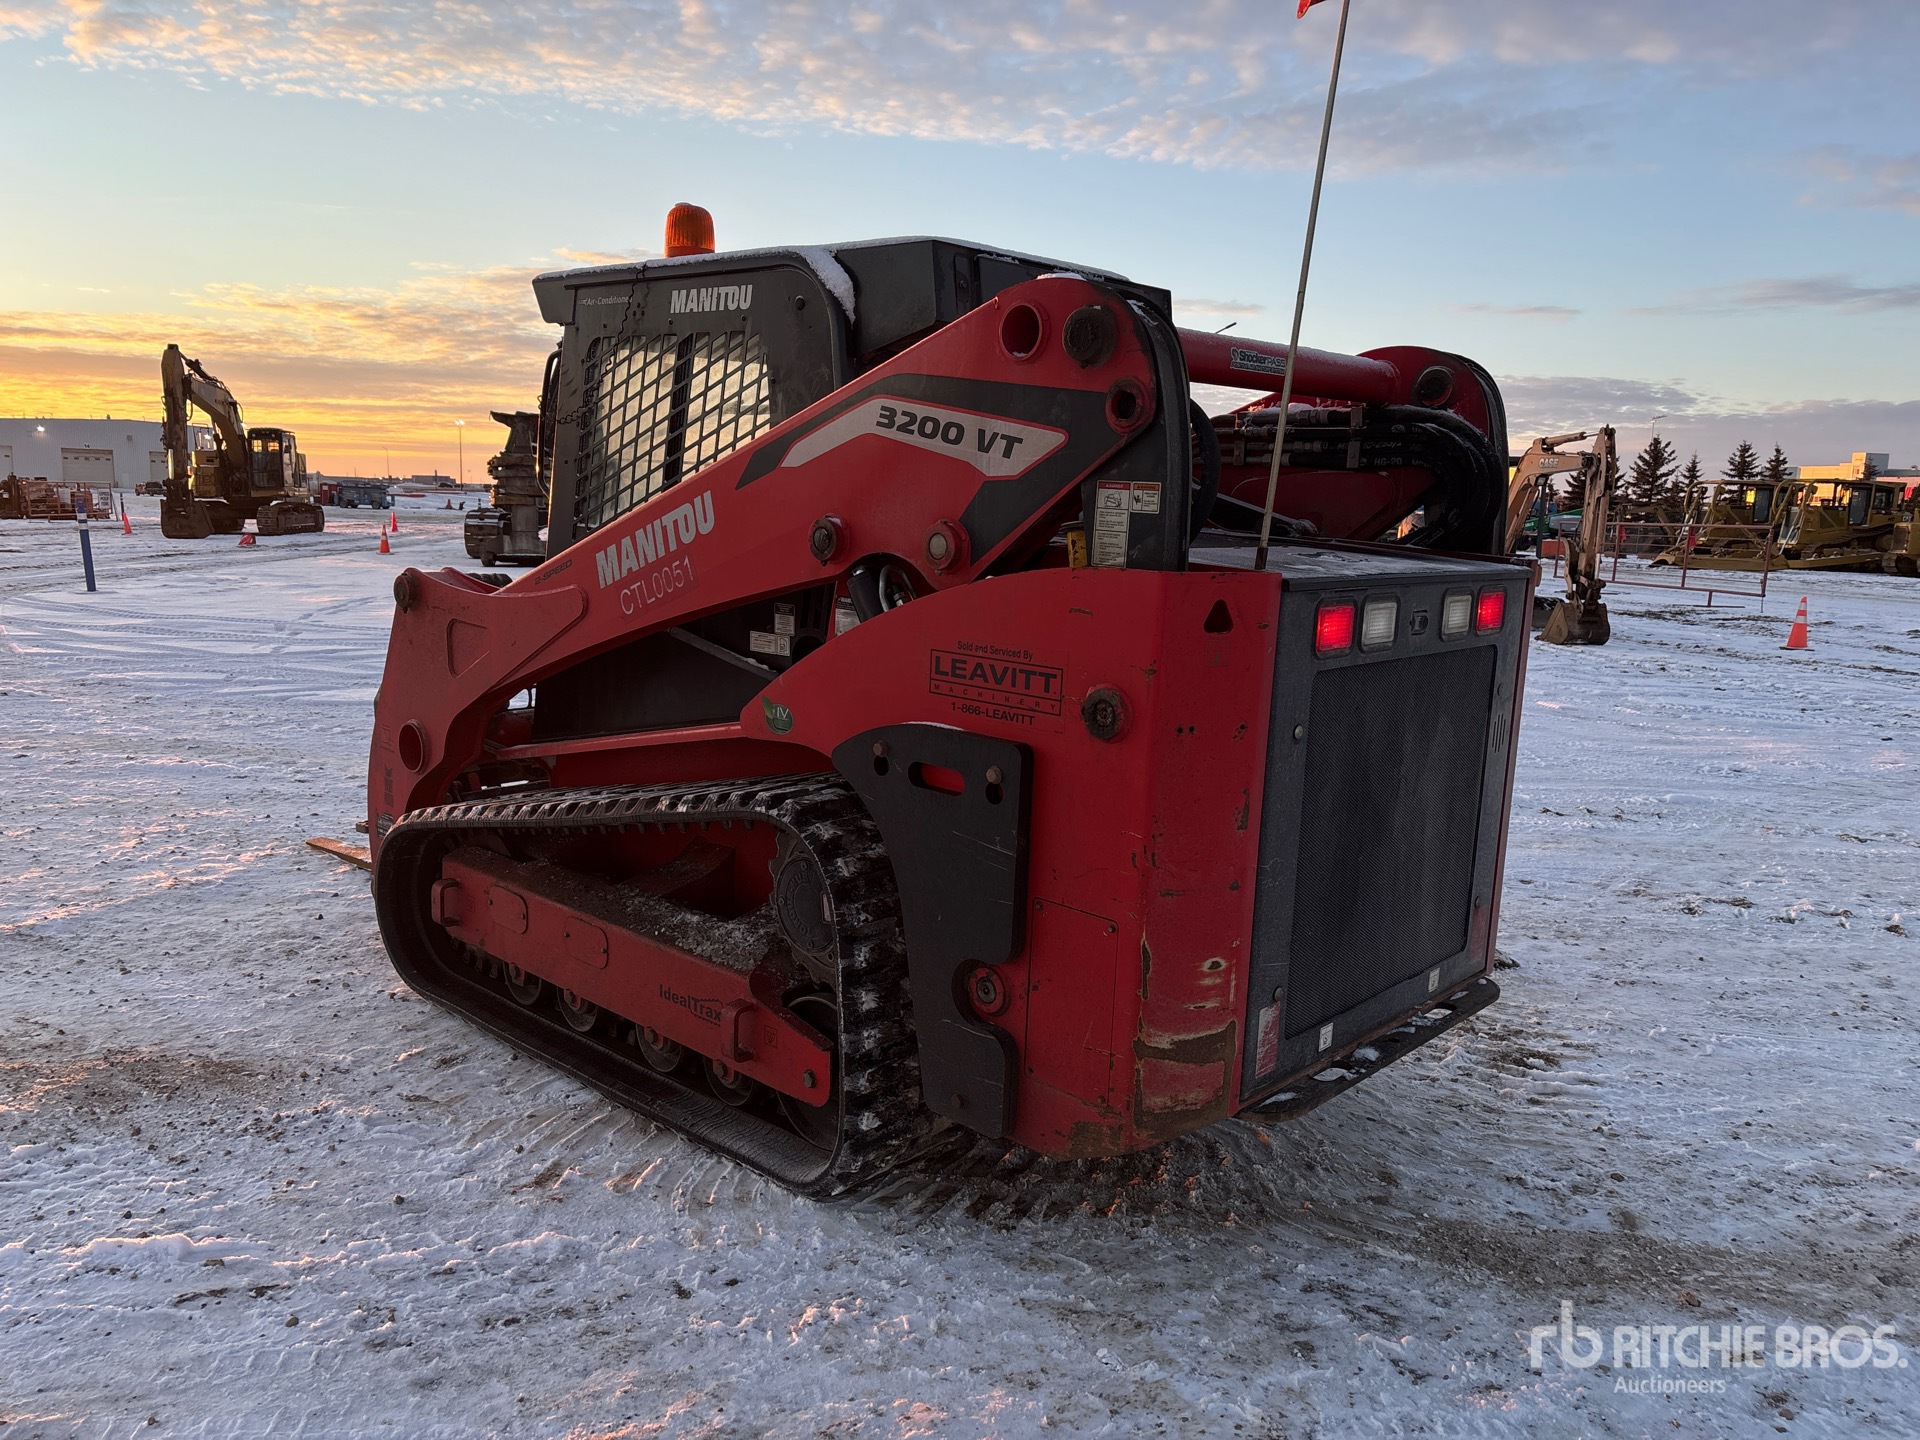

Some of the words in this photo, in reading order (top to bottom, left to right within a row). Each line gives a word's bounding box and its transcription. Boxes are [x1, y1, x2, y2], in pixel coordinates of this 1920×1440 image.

[670, 285, 752, 314] MANITOU
[876, 405, 965, 446] 3200
[977, 429, 1023, 459] VT
[1539, 458, 1559, 467] CASE
[595, 490, 714, 589] MANITOU
[534, 559, 573, 585] 2-SPEED
[620, 555, 694, 615] CTL0051
[957, 641, 973, 650] Sold
[975, 643, 988, 654] and
[989, 645, 1021, 659] Serviced
[1023, 651, 1033, 662] By
[934, 656, 1057, 693] LEAVITT
[951, 702, 1035, 726] 1-866-LEAVITT
[659, 983, 722, 1021] IdealTrax
